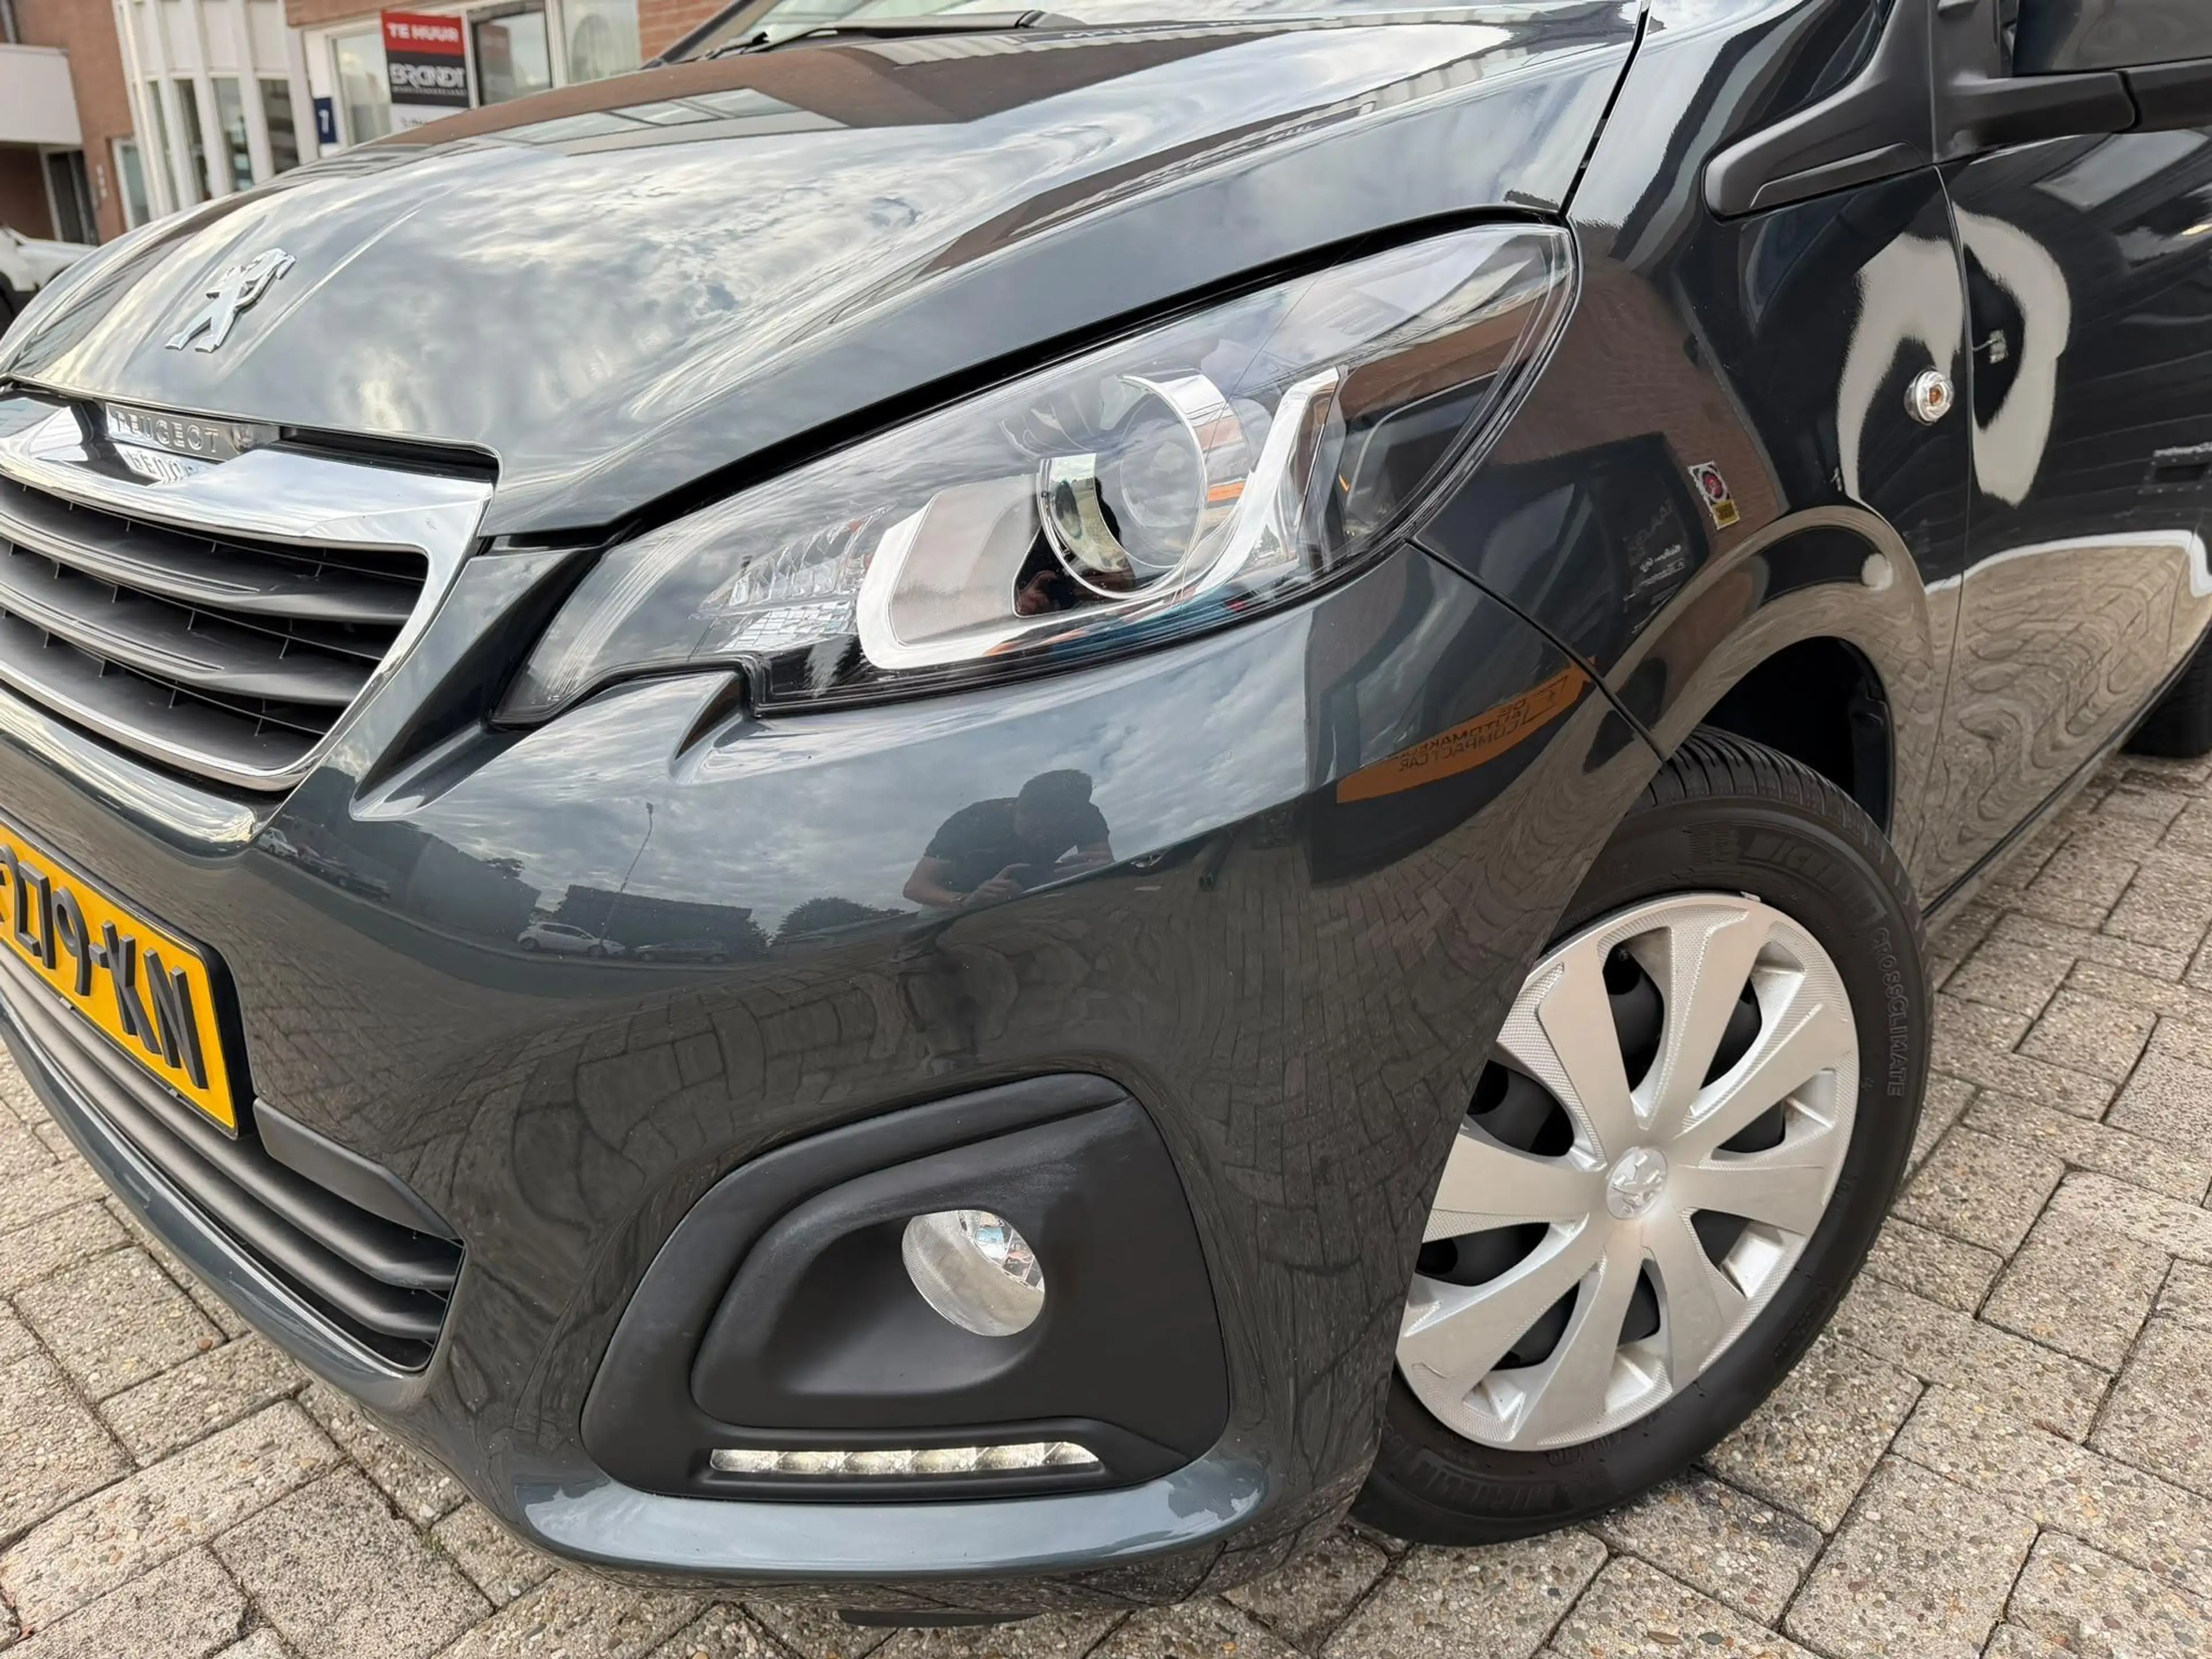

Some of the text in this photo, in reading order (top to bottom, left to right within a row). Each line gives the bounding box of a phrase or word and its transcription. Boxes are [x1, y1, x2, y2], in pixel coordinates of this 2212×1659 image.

[387, 22, 459, 43] TE HUUR
[115, 410, 219, 454] PEUGEOT
[1874, 927, 1908, 1097] CROSSCLIMATE
